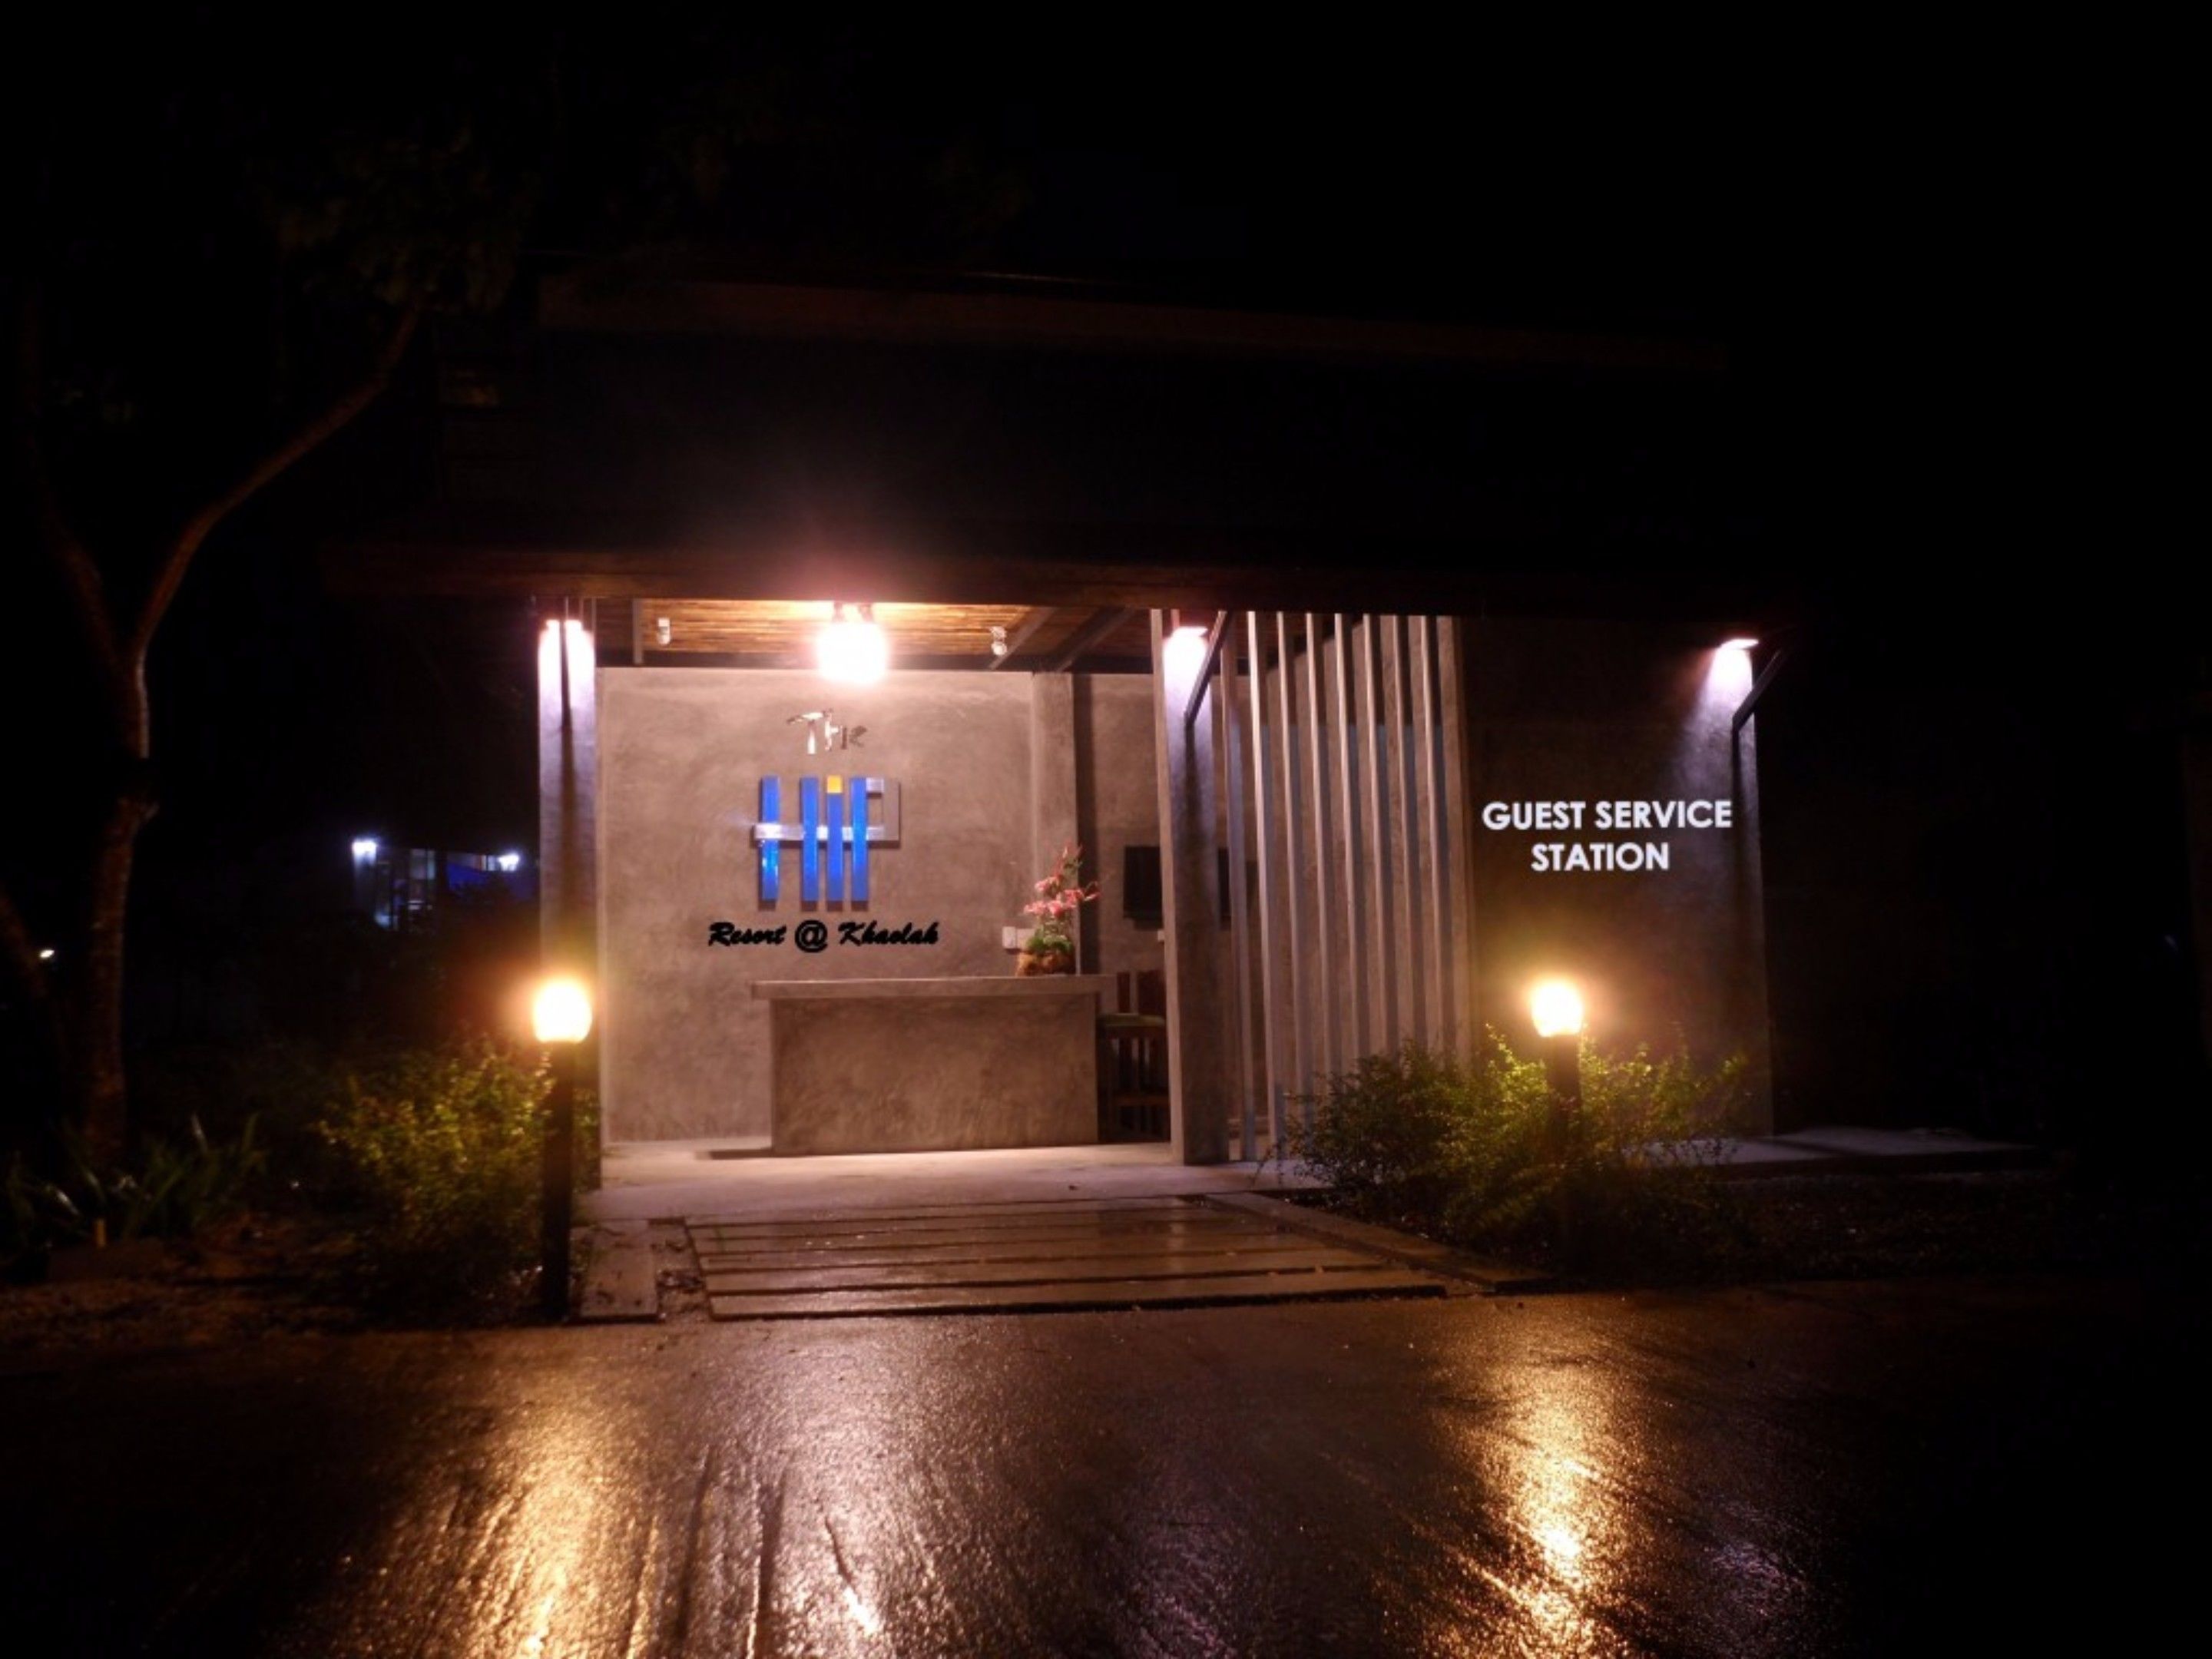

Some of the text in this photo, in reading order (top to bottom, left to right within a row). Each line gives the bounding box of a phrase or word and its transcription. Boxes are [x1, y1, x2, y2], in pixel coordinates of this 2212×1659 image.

[1482, 800, 1734, 830] GUEST SERVICE
[1531, 842, 1670, 872] STATION
[708, 921, 786, 946] Resort
[794, 919, 829, 953] @
